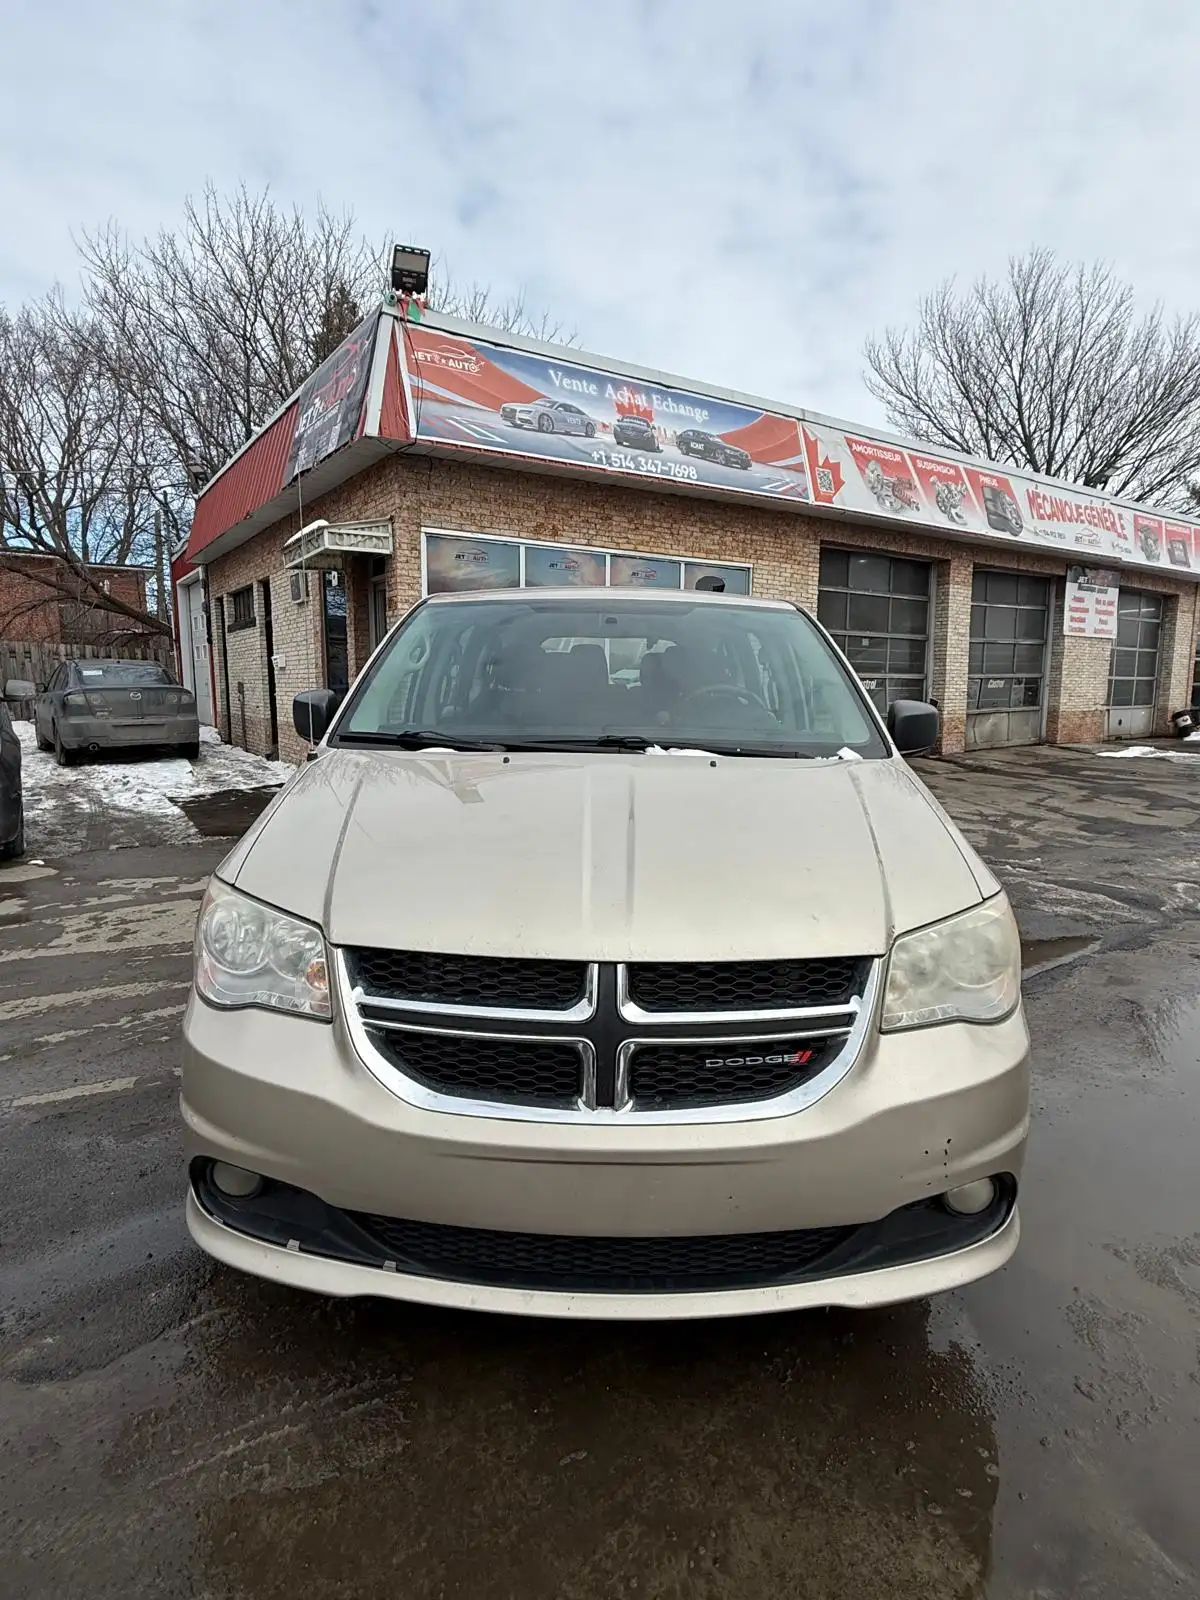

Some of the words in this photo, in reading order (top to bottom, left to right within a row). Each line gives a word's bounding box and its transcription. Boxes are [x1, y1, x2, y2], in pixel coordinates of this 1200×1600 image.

[548, 368, 599, 395] Vente
[604, 383, 648, 408] Achat
[652, 393, 710, 423] Echange
[851, 442, 902, 463] AMORTISSEUR
[638, 456, 698, 480] 347-7698
[916, 459, 956, 476] SUSPENSION
[705, 1053, 800, 1069] DODGE
